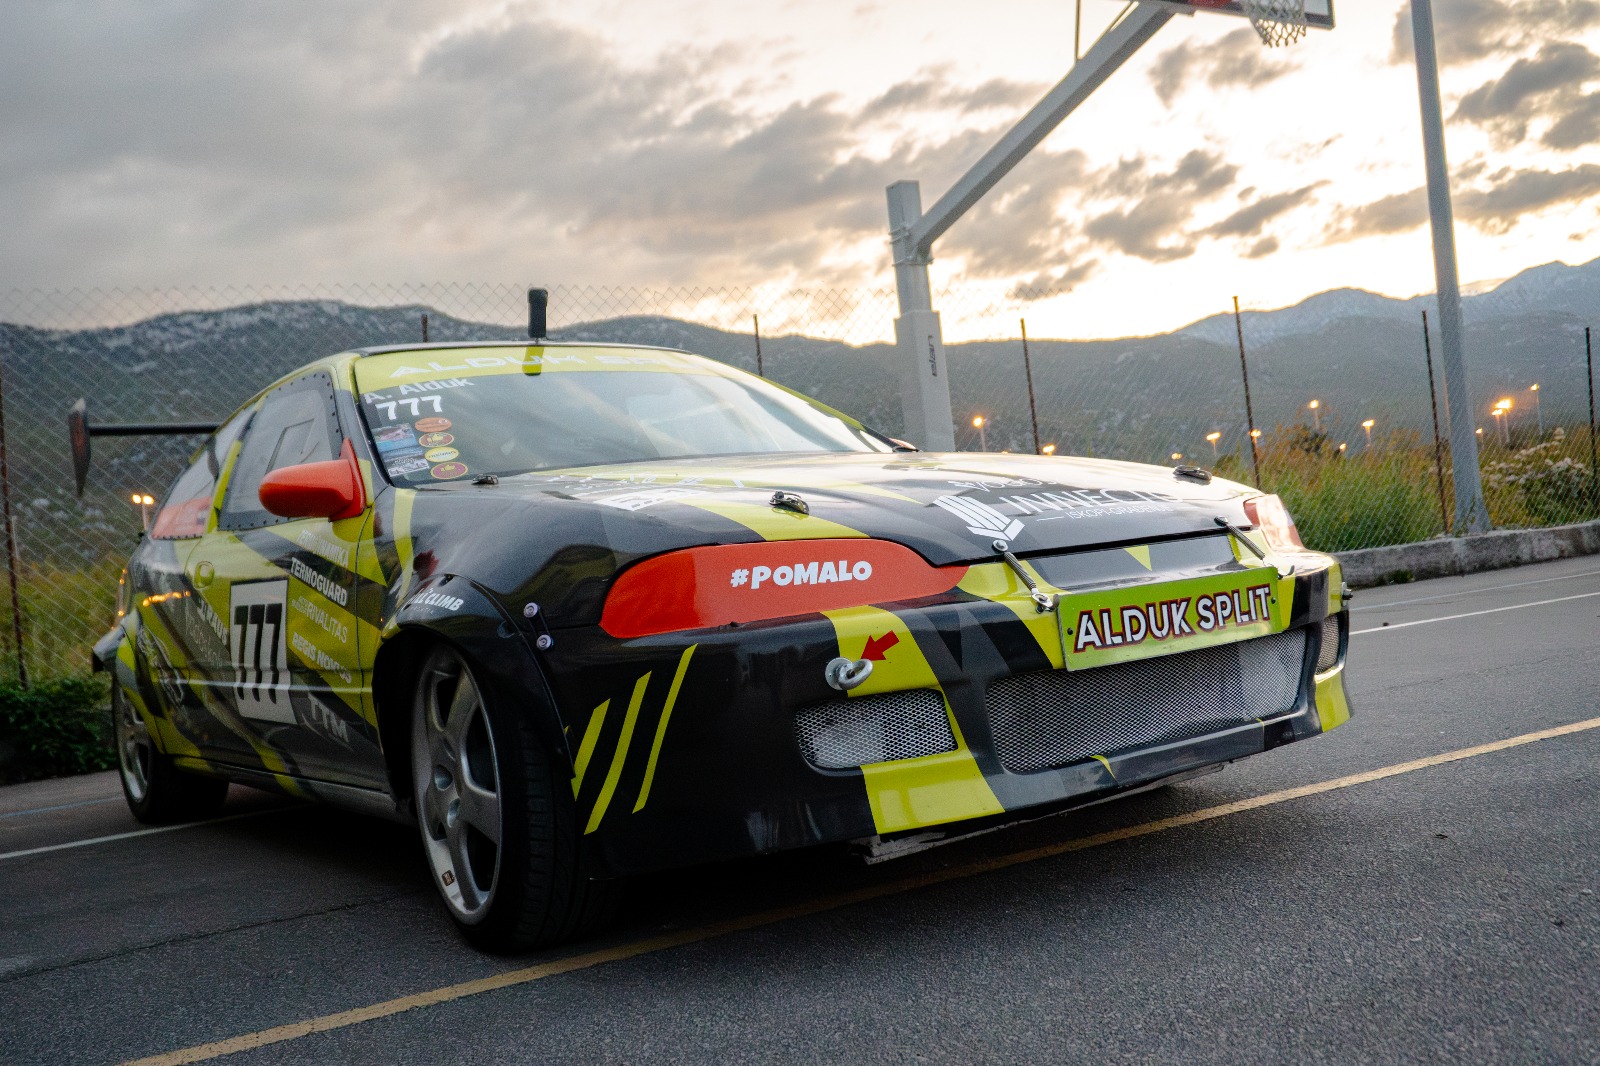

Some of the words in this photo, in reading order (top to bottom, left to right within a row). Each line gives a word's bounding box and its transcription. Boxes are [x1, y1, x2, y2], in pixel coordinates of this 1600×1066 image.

[389, 354, 588, 379] ALDUK
[363, 392, 393, 405] A.
[399, 378, 475, 395] Alduk
[374, 394, 443, 421] 777
[290, 556, 348, 606] TERMOGUARD
[729, 559, 873, 590] #POMALO
[306, 601, 348, 643] RIVALITAS
[1075, 599, 1194, 652] ALDUK
[1197, 585, 1271, 632] SPLIT
